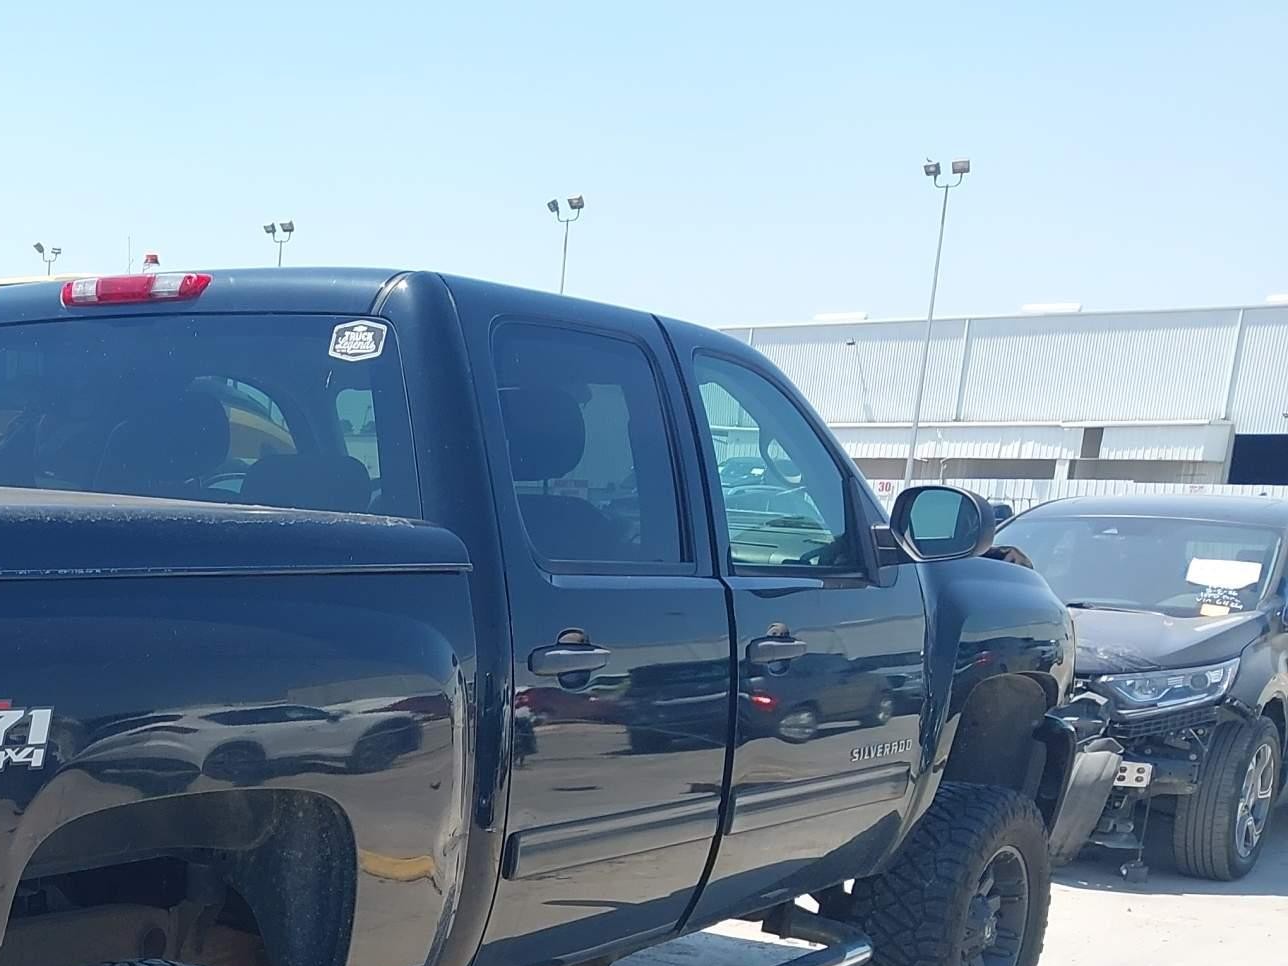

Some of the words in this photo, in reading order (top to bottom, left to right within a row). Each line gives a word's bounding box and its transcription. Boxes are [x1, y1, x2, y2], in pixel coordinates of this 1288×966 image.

[344, 331, 374, 342] TRUCK
[335, 337, 376, 353] Legends
[878, 481, 892, 492] 30
[851, 739, 912, 761] SILVERADO
